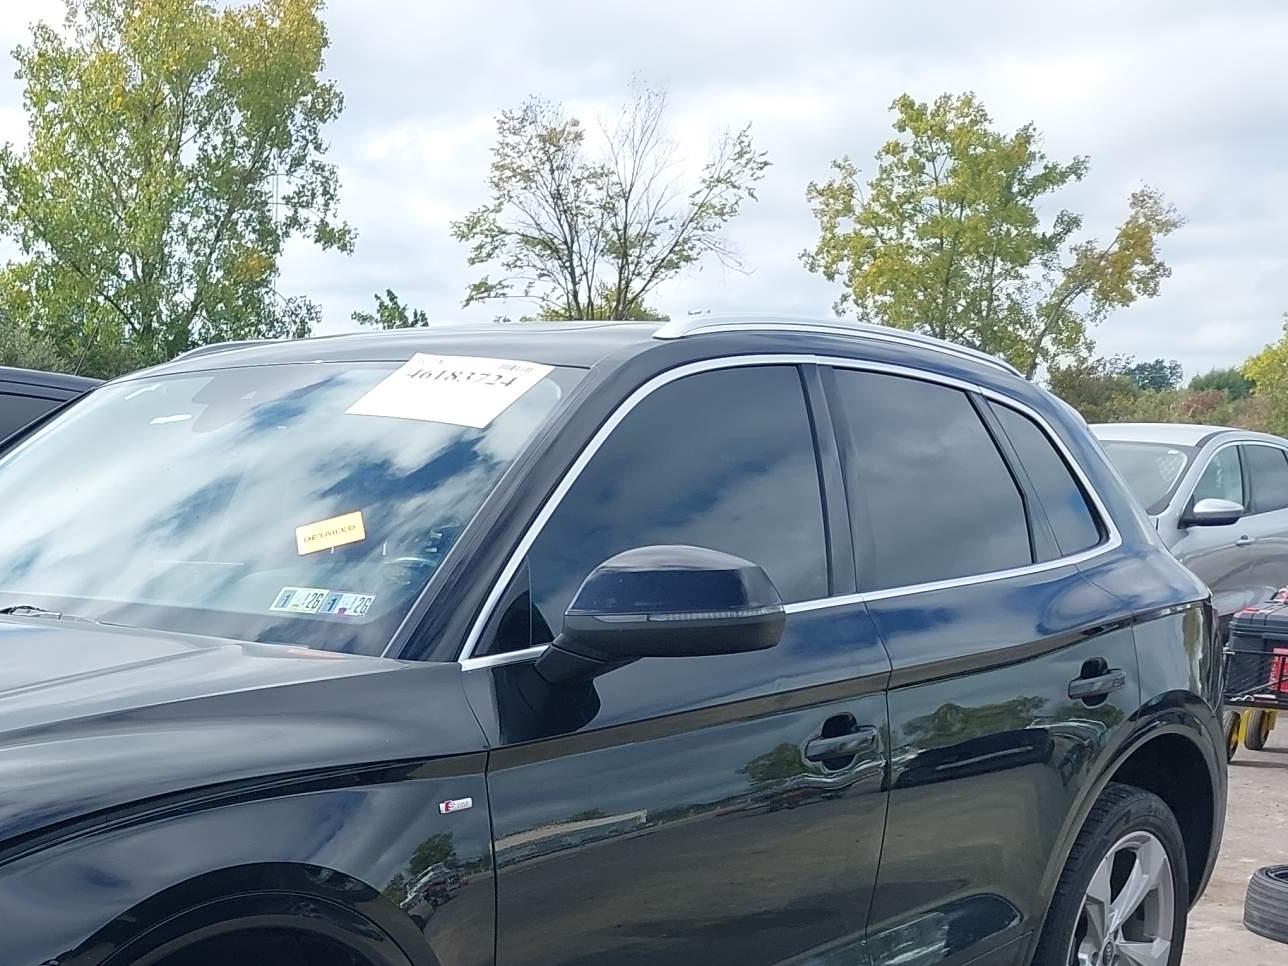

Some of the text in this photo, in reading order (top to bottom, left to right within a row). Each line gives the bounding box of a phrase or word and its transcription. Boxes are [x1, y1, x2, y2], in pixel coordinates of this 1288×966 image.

[406, 368, 519, 388] 46183724
[305, 592, 324, 609] 26
[353, 596, 372, 614] 26
